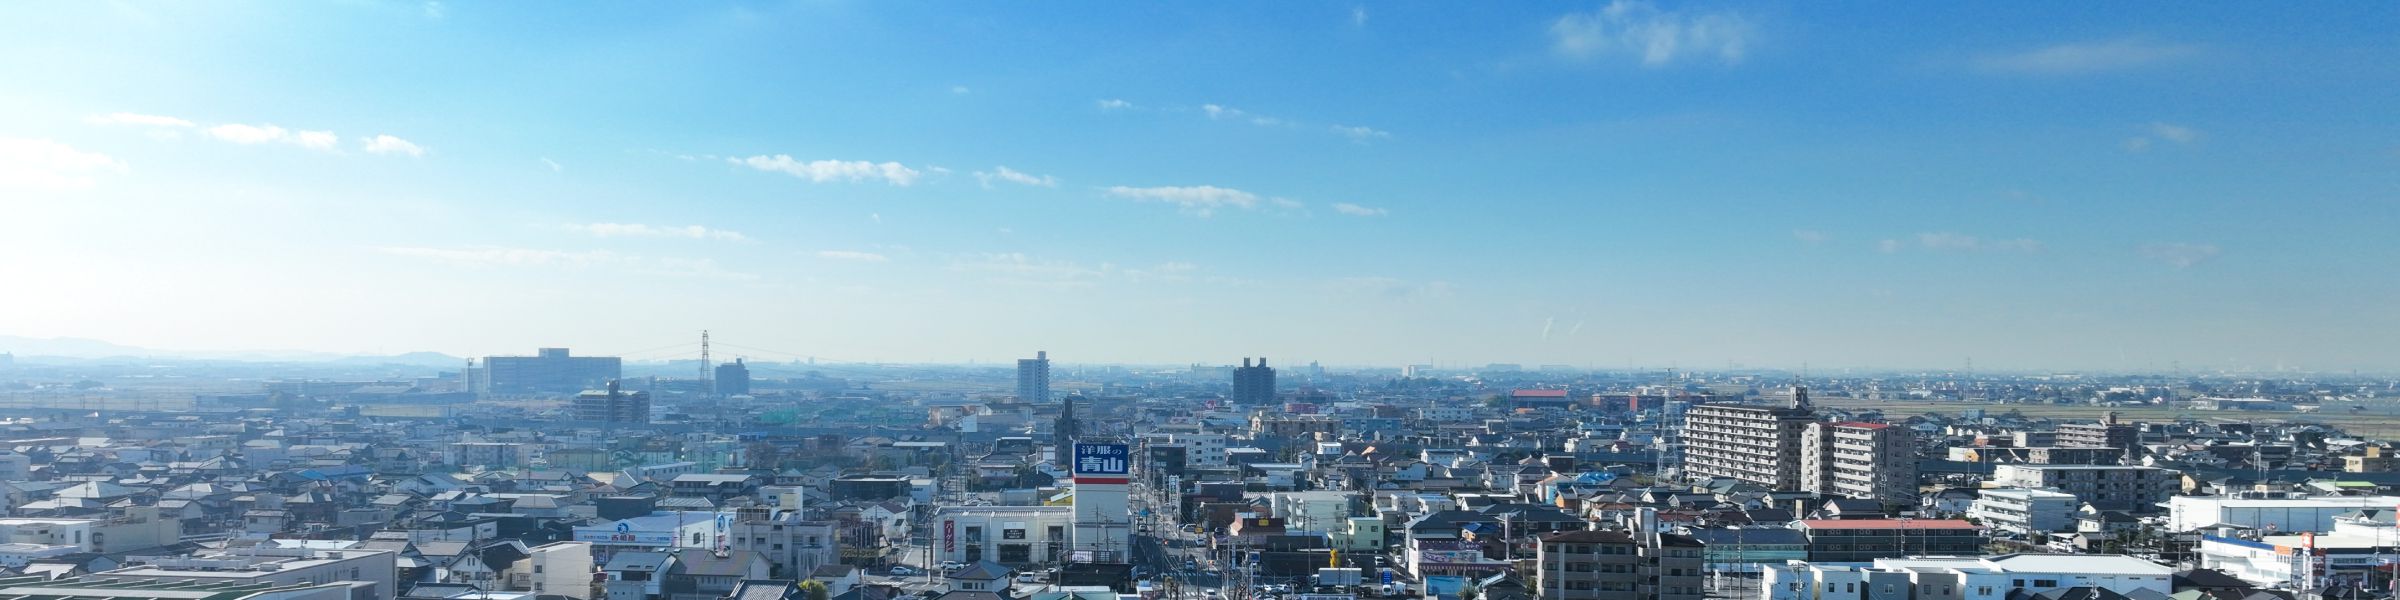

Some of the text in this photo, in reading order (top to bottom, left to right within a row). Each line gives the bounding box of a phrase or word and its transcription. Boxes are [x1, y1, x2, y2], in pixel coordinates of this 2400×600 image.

[1081, 445, 1122, 455] 洋服の
[1080, 456, 1123, 472] 青山
[945, 522, 954, 551] バーゲン
